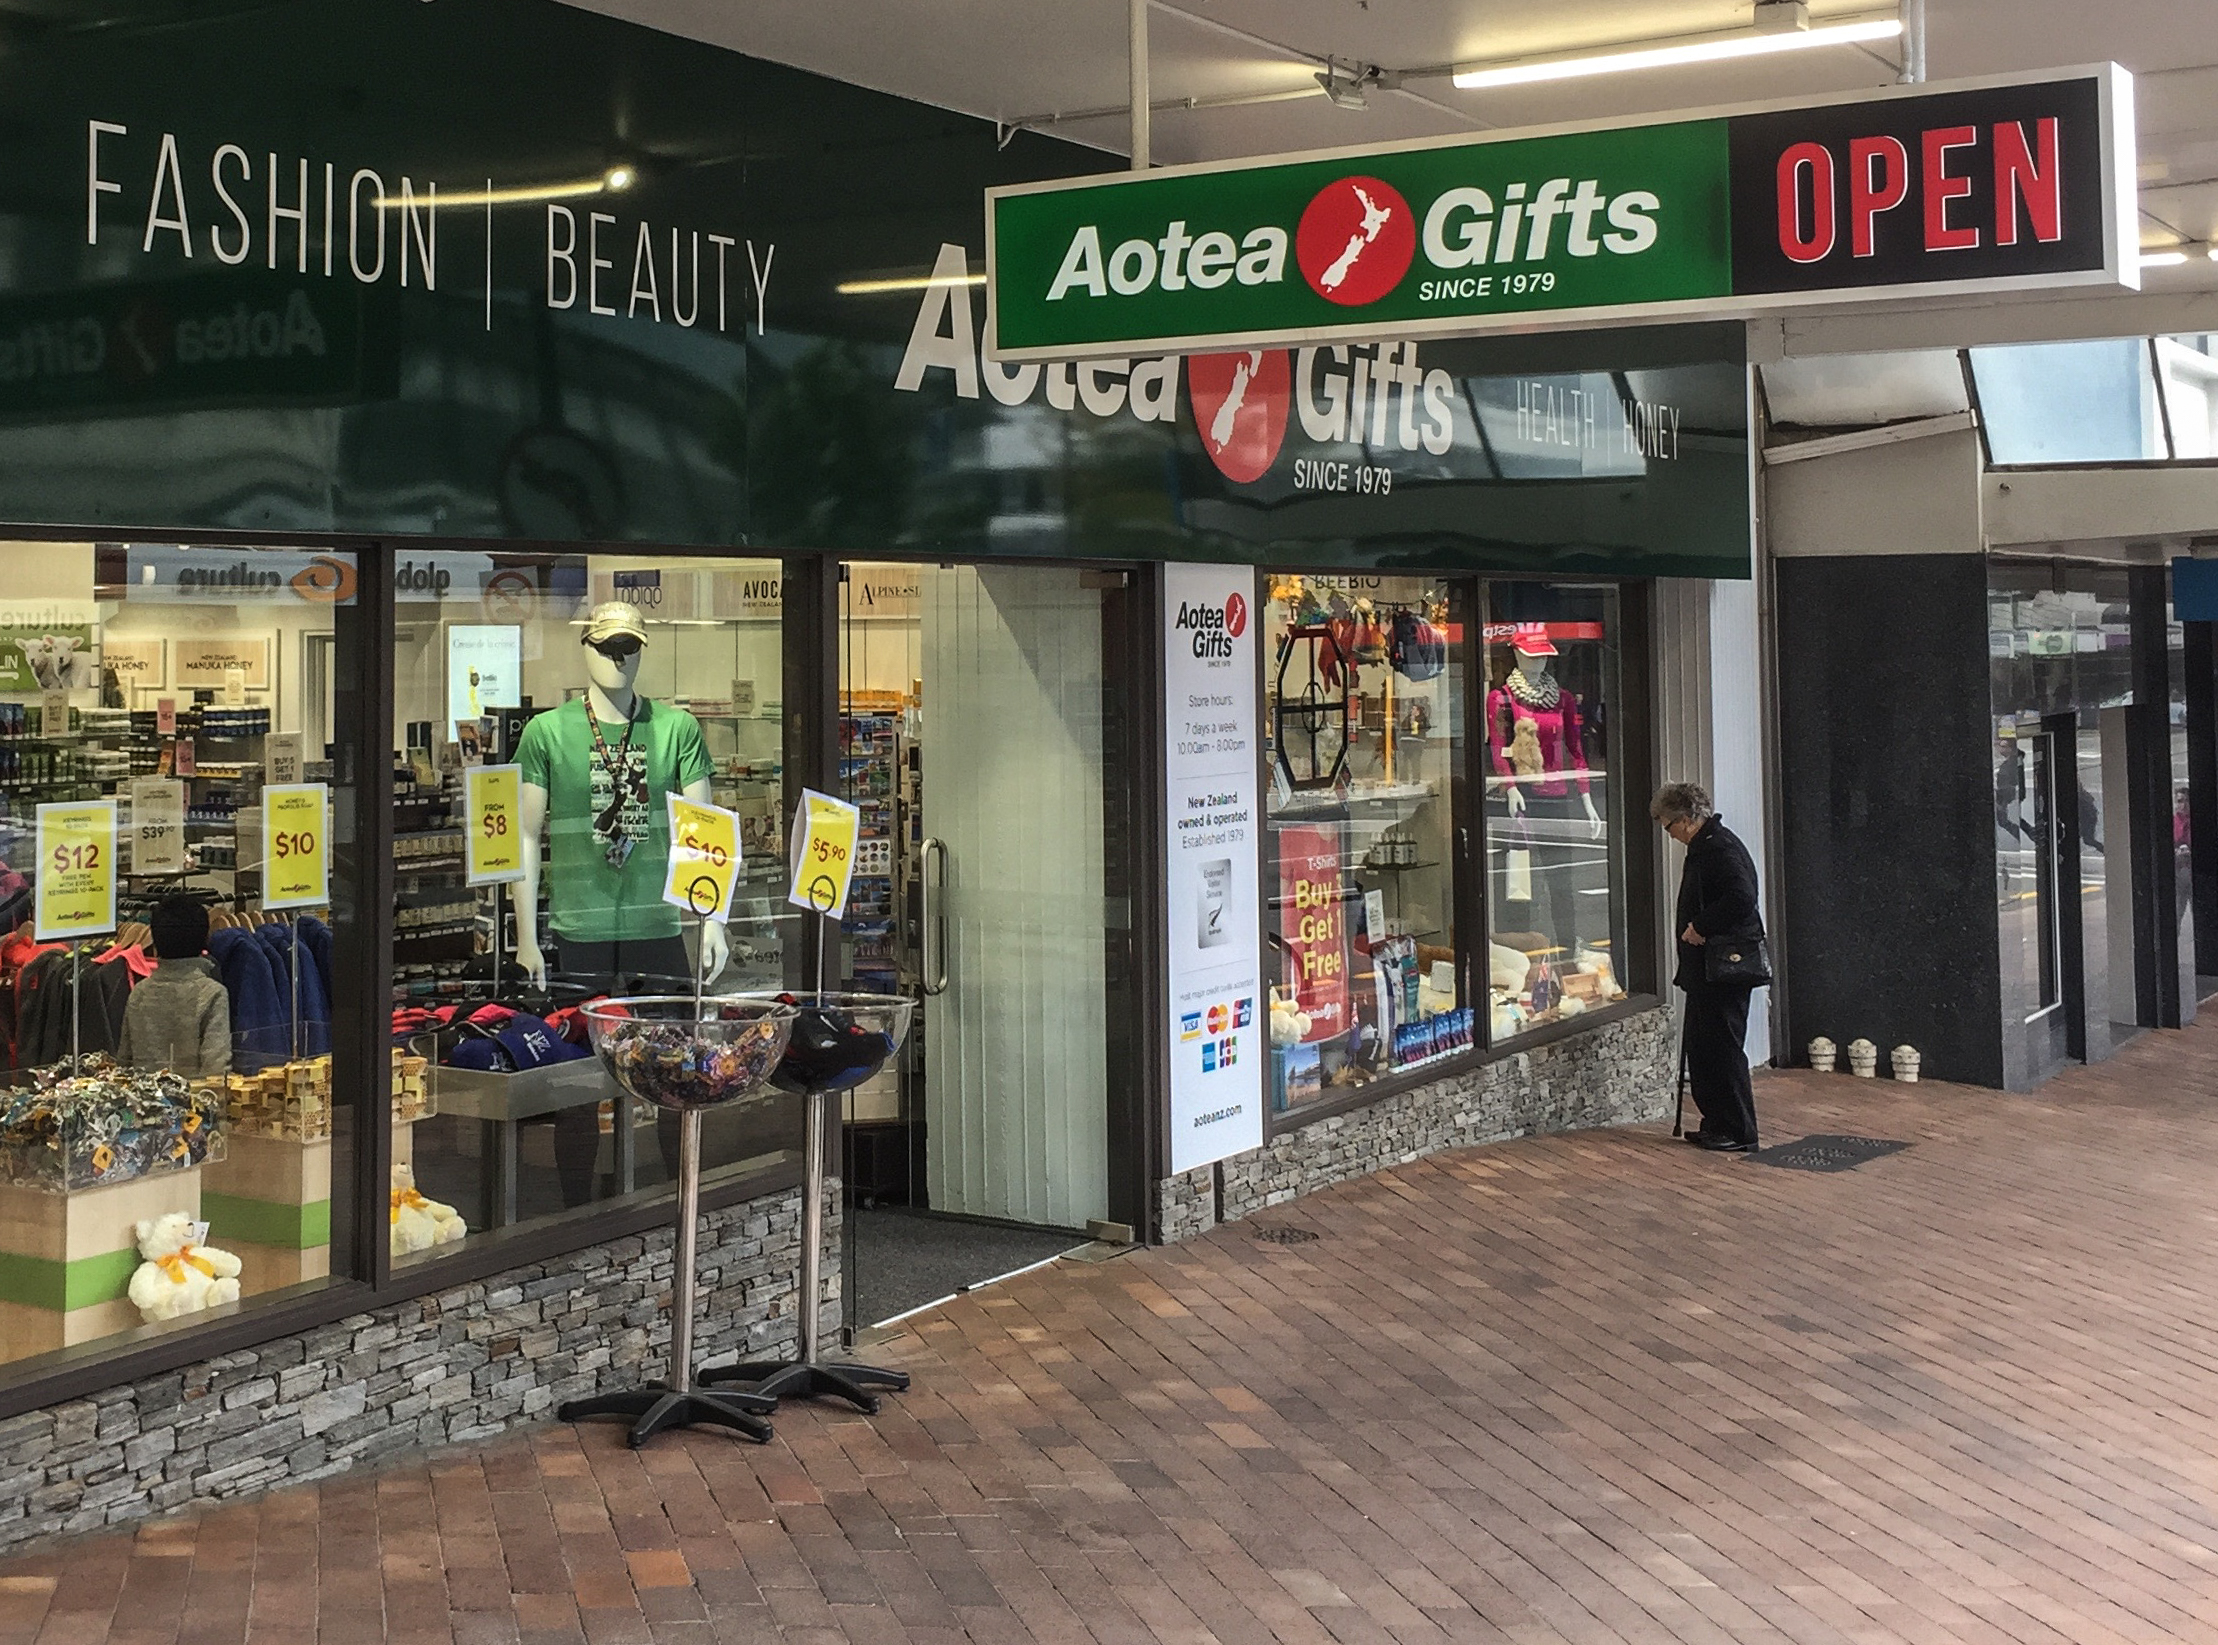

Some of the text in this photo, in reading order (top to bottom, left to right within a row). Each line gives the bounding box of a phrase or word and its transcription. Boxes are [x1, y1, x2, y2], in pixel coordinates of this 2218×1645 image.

[1776, 116, 2062, 264] OPEN
[88, 119, 776, 336] FASHION BEAUTY
[1045, 177, 1661, 301] Aotea Gifts
[1418, 271, 1556, 301] SINCE 1979
[1516, 379, 1680, 460] HEALTH HONEY
[1293, 458, 1392, 496] SINCE 1979
[1175, 600, 1224, 629] Aotea
[1192, 630, 1233, 658] Gifts
[186, 661, 221, 670] MANUKA
[1188, 694, 1209, 708] Store
[1185, 719, 1238, 737] 7 days a week
[275, 774, 293, 782] FREE
[484, 803, 505, 812] FROM
[1187, 791, 1238, 809] New Zealand
[483, 813, 508, 839] $8
[1177, 808, 1248, 830] owned & operated
[276, 831, 315, 859] $10
[811, 837, 847, 863] $5.90
[1182, 828, 1244, 849] Established 1979
[53, 843, 100, 874] $12
[1306, 855, 1338, 871] T-Shirts
[1295, 878, 1332, 911] Buy
[1300, 911, 1334, 944] Get
[1303, 950, 1341, 980] Free
[1183, 1019, 1199, 1032] VISA
[1194, 1104, 1242, 1128] aoteanz.com
